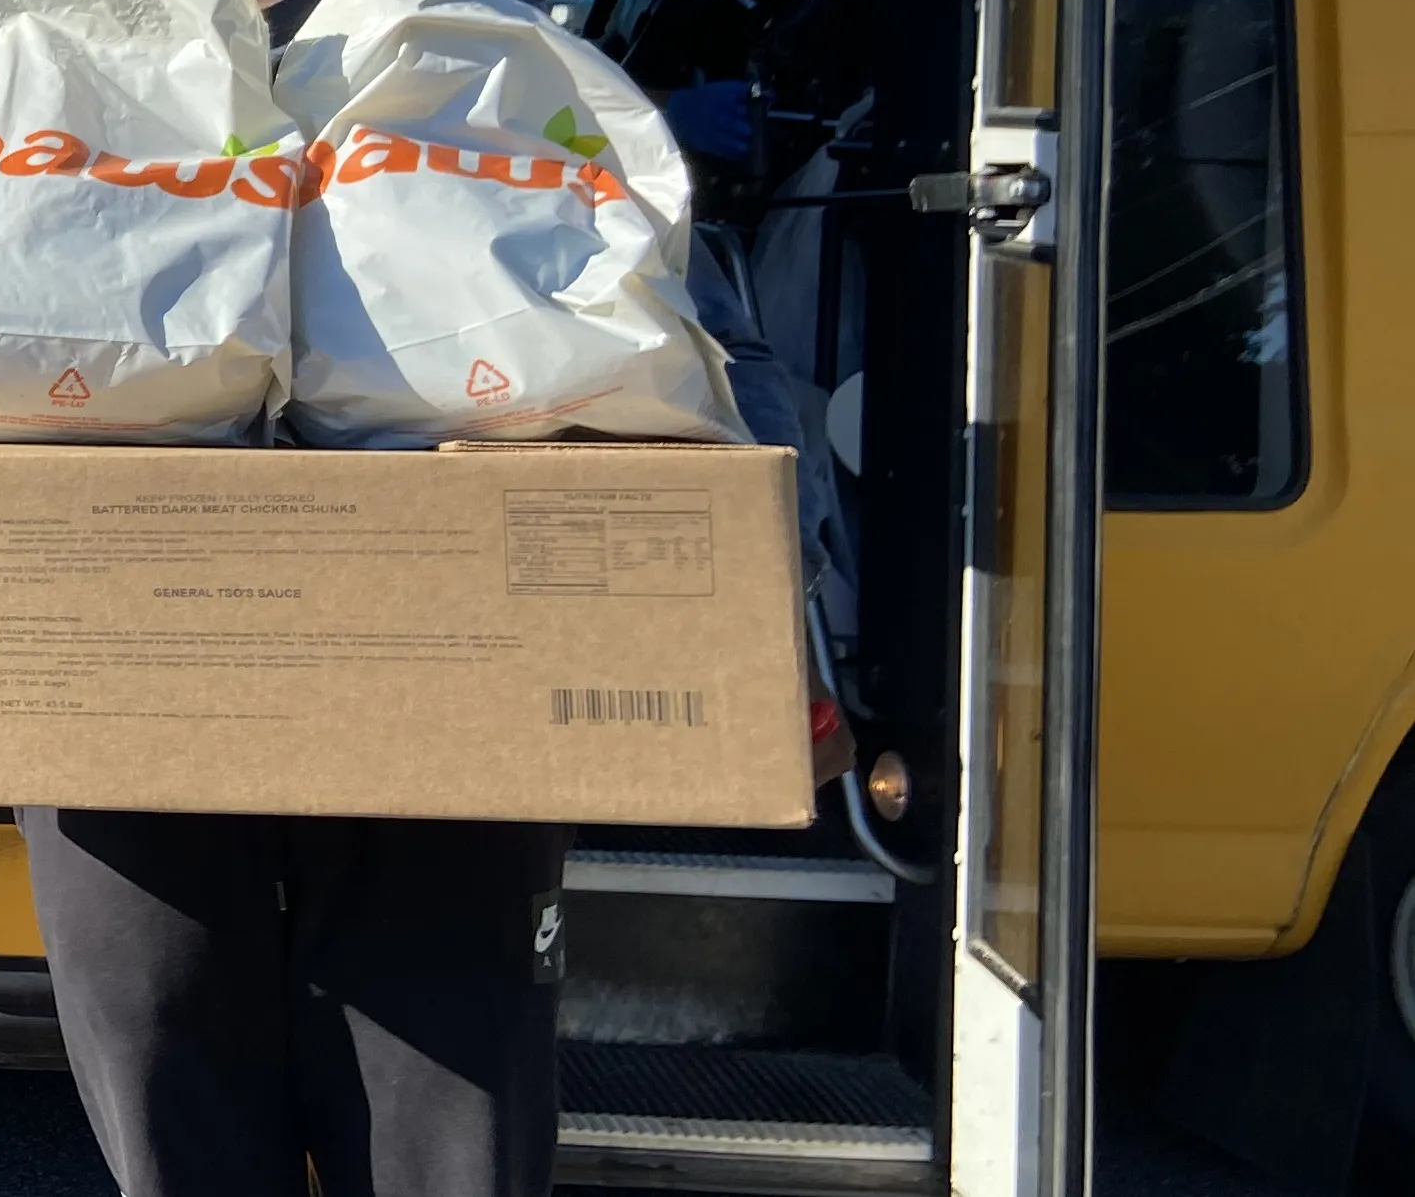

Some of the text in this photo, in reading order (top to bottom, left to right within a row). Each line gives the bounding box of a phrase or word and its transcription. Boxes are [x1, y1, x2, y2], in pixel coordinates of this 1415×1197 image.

[135, 494, 166, 503] KEEP
[169, 494, 217, 503] FROZEN
[226, 494, 261, 503] FULLY
[264, 493, 316, 502] COOKED
[91, 504, 357, 515] BATTERED DARK MEAT CHICKEN CHUNKS
[153, 588, 302, 598] GENERAL TSO'S SAUCE
